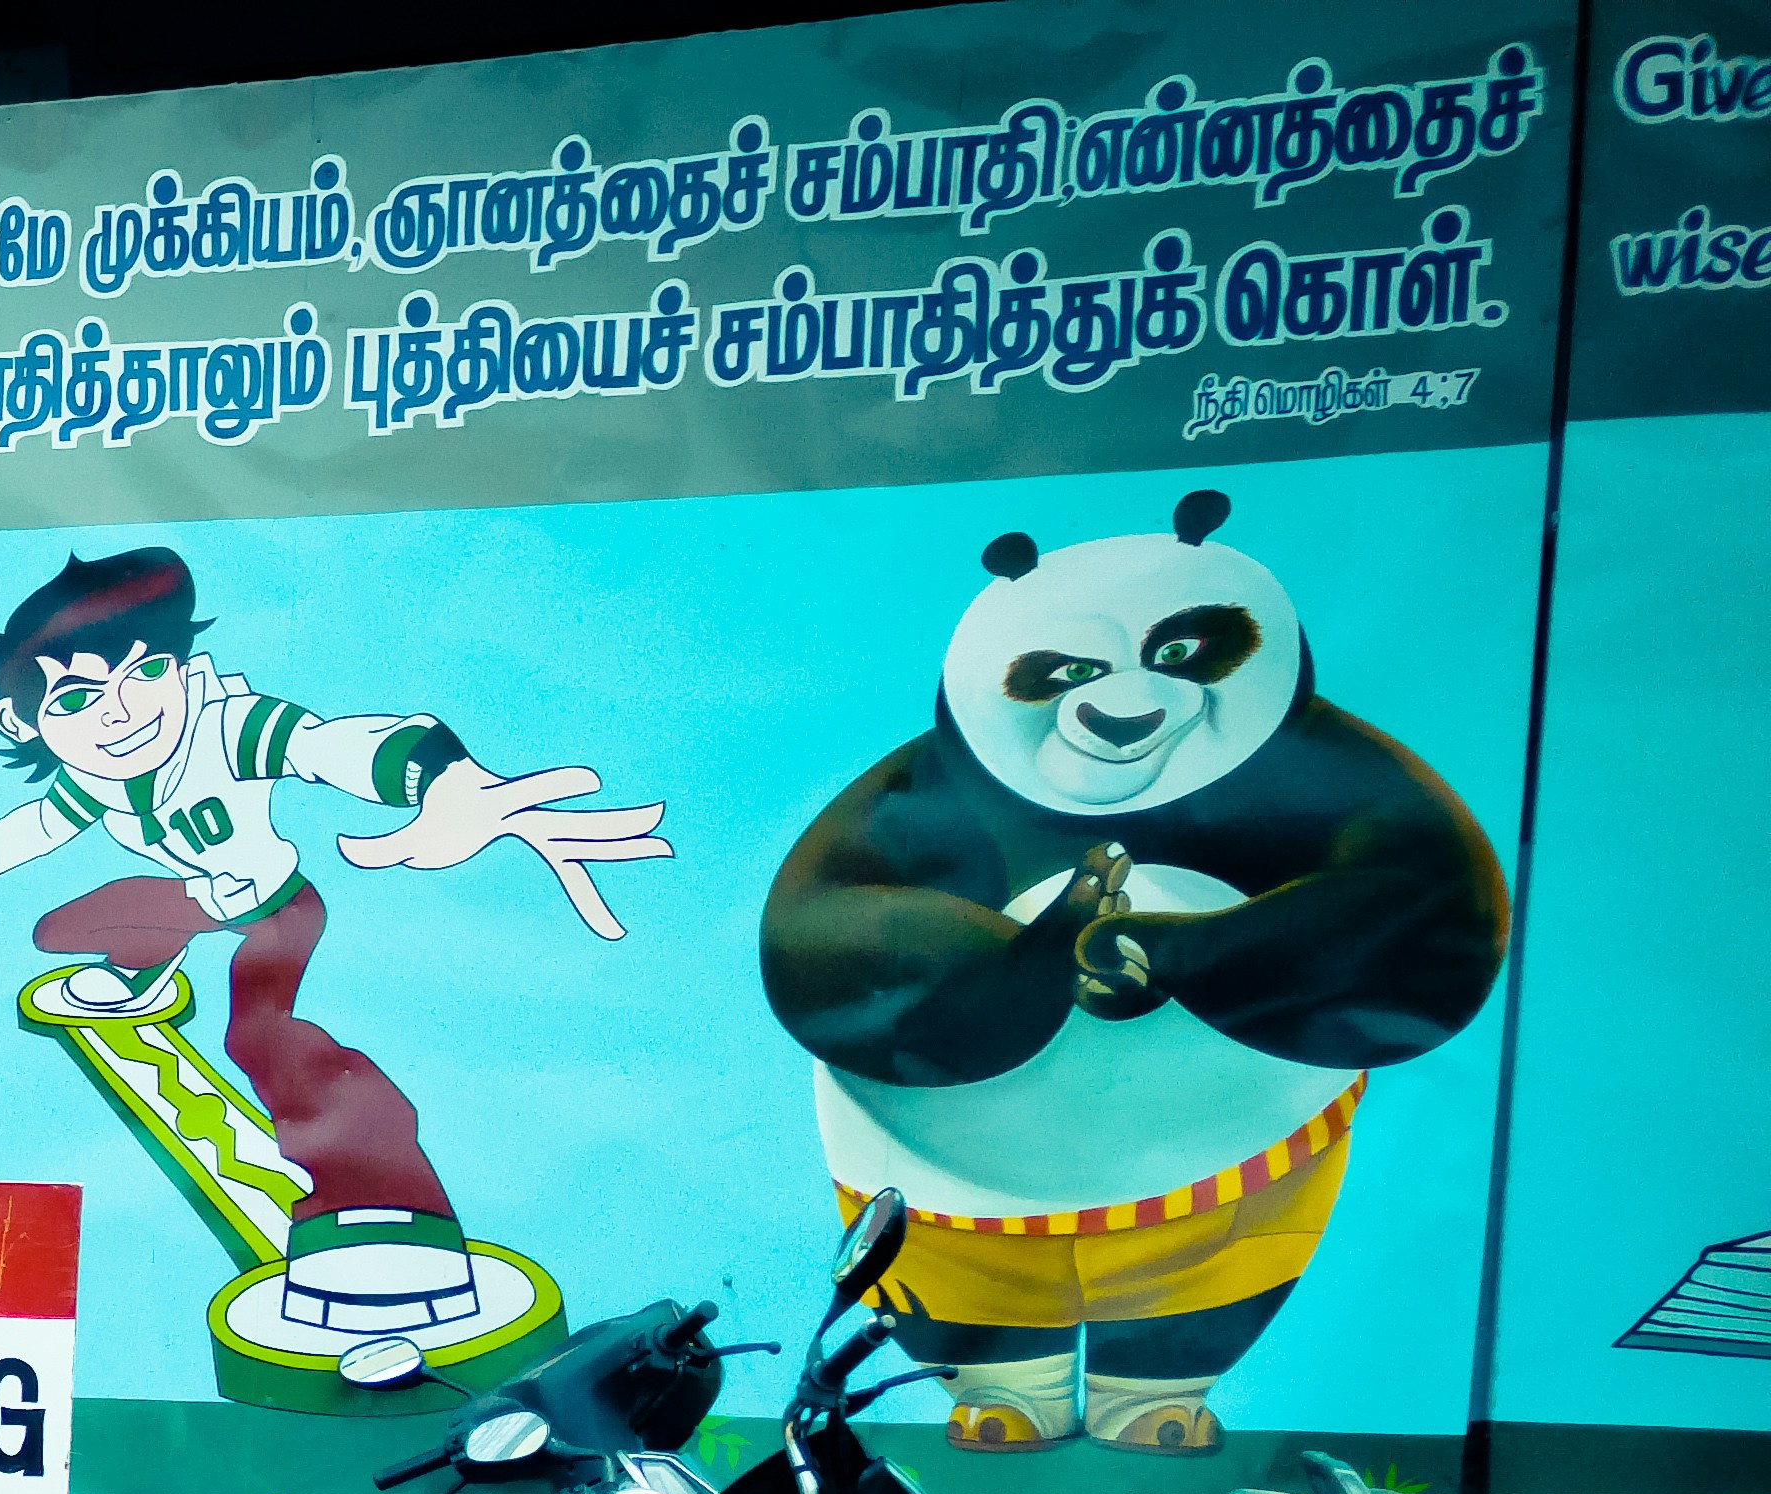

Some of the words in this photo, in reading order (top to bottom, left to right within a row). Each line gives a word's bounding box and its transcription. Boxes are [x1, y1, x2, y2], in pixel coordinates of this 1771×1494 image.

[348, 284, 696, 430] புத்தியைச்
[712, 234, 1203, 398] சம்பாதித்துக்
[169, 796, 234, 855] 10
